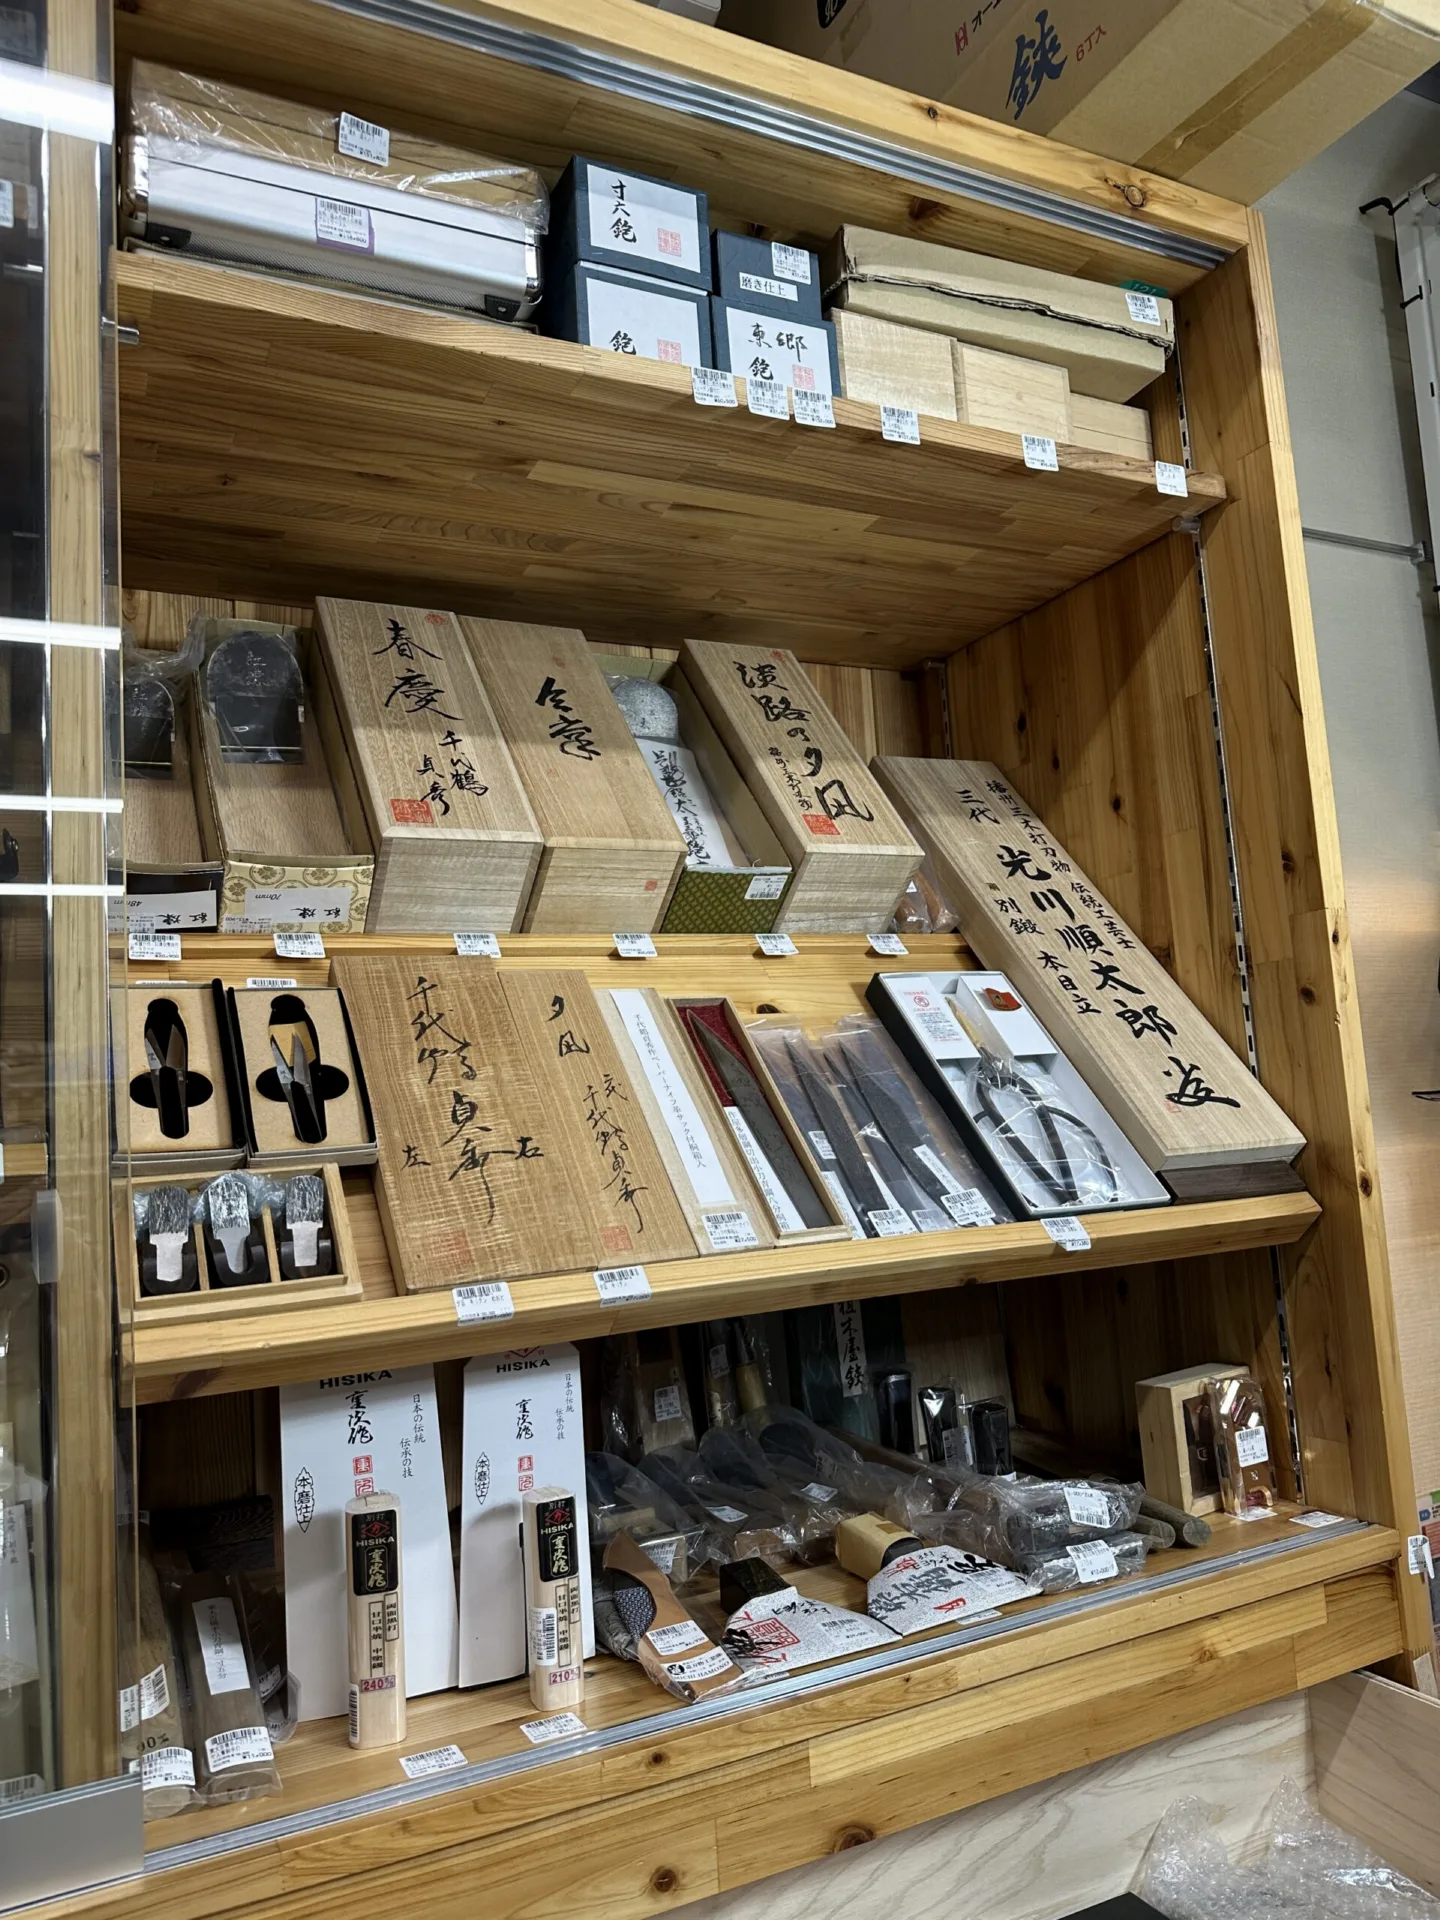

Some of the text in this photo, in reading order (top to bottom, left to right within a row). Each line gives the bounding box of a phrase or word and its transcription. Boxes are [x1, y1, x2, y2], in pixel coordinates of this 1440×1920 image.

[609, 179, 637, 243] 寸六鉋
[741, 276, 786, 297] 磨き仕上
[955, 788, 1001, 825] 三代
[255, 893, 282, 901] 70mm
[1069, 882, 1136, 951] 伝統工芸士
[547, 995, 590, 1057] 夕凪
[401, 1144, 431, 1171] 左
[514, 1136, 544, 1160] 右
[320, 1370, 392, 1389] HISIKA
[496, 1358, 550, 1373] HISIKA
[565, 1373, 575, 1413] 日本の伝統
[412, 1393, 426, 1444] 日本の伝統
[556, 1408, 566, 1440] 伝承の技
[400, 1438, 414, 1478] 伝承の技
[477, 1460, 489, 1498] 本磨仕上
[297, 1476, 313, 1525] 本磨仕上
[356, 1536, 395, 1547] HISIKA
[540, 1522, 574, 1535] HISIKA
[697, 1661, 730, 1679] HAMONO
